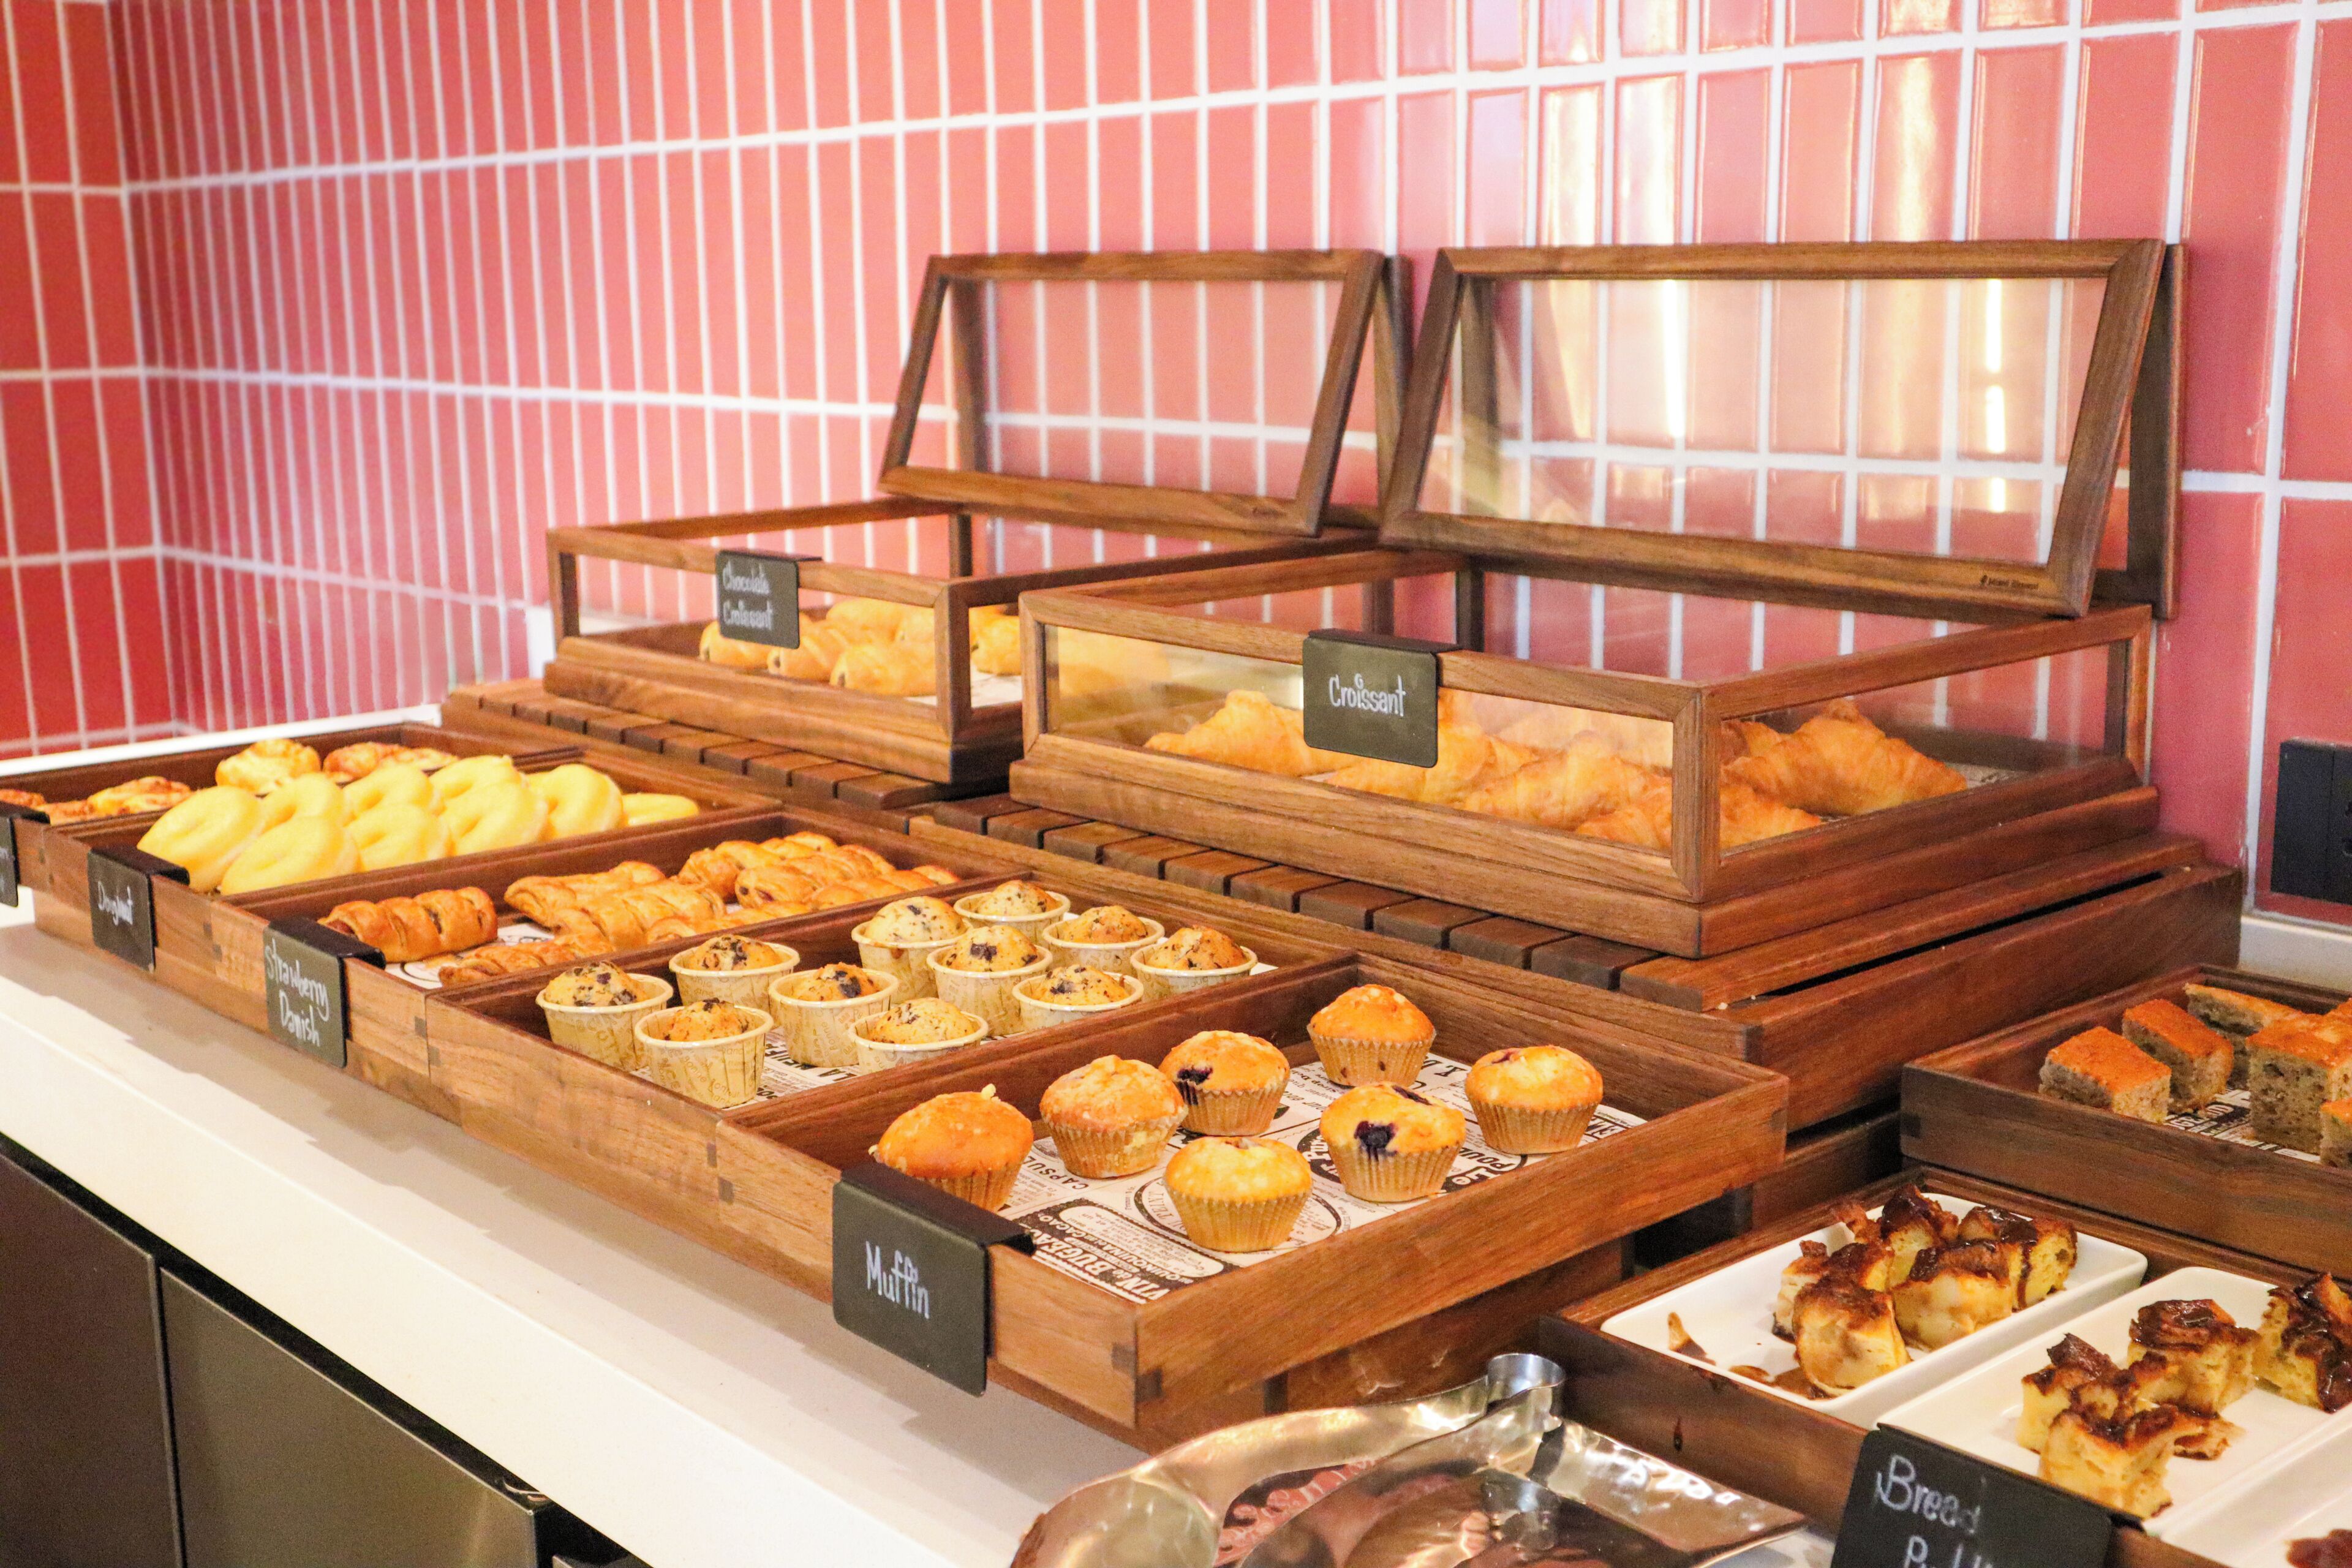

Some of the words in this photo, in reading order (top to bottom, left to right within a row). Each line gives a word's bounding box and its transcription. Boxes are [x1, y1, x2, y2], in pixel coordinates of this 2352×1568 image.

[1329, 673, 1406, 717] Croissant
[265, 938, 330, 1022] Strawberry
[279, 989, 320, 1047] Danish
[1023, 1156, 1089, 1189] CAPSUL
[865, 1240, 929, 1319] Muffin
[1116, 1277, 1170, 1300] VIN
[1876, 1454, 1986, 1535] Bread
